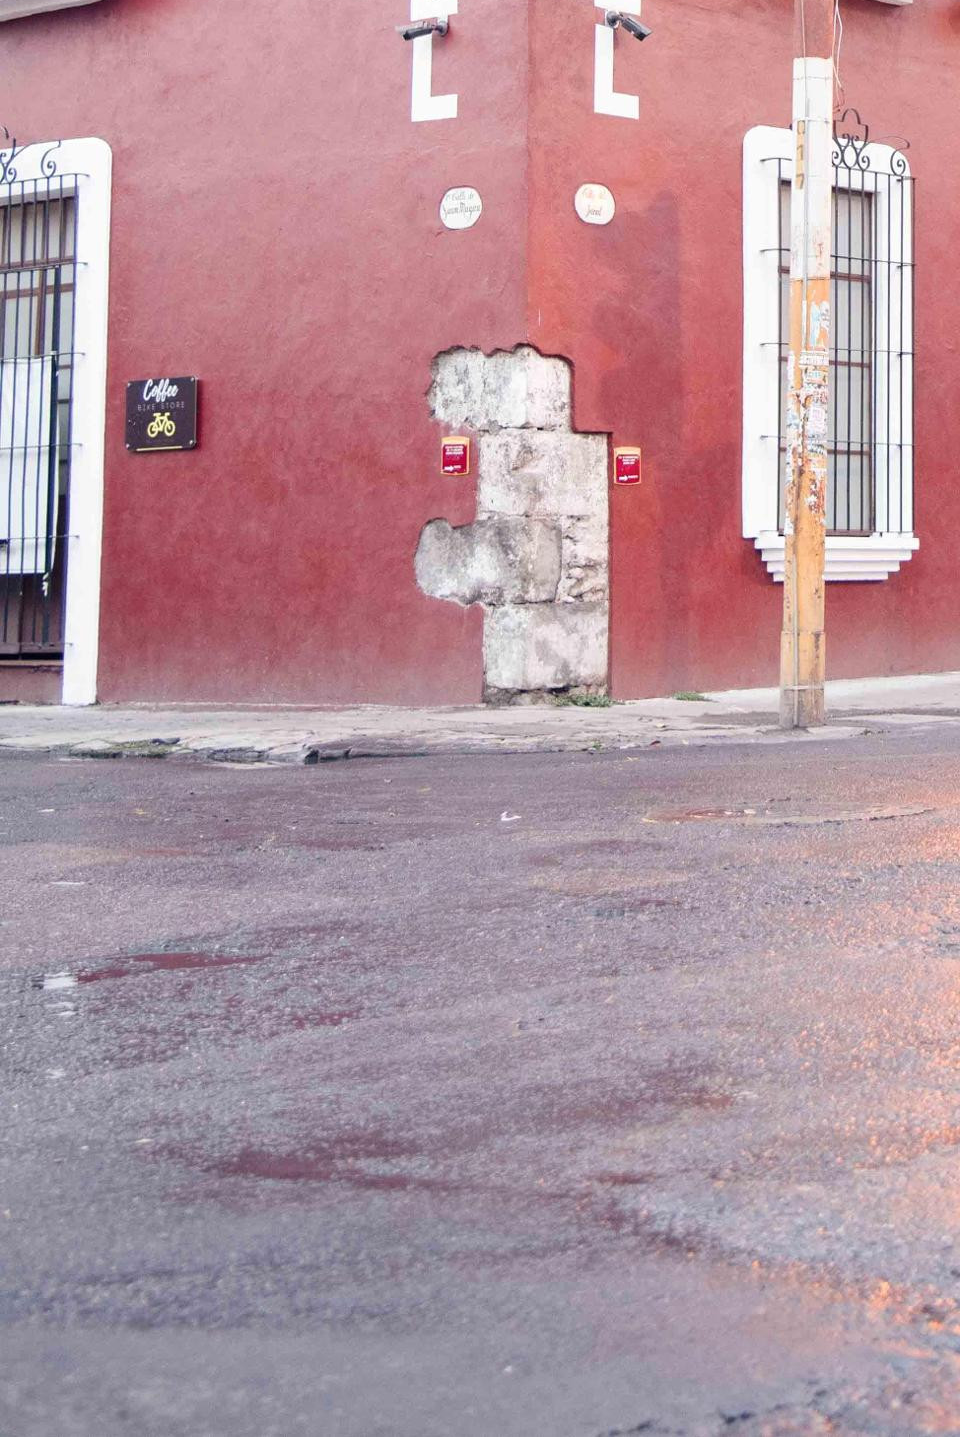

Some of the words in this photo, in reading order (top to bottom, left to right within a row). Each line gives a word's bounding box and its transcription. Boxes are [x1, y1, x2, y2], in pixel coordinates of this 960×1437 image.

[143, 378, 179, 402] Coffee
[138, 403, 155, 412] BIKE
[161, 401, 185, 410] STORE
